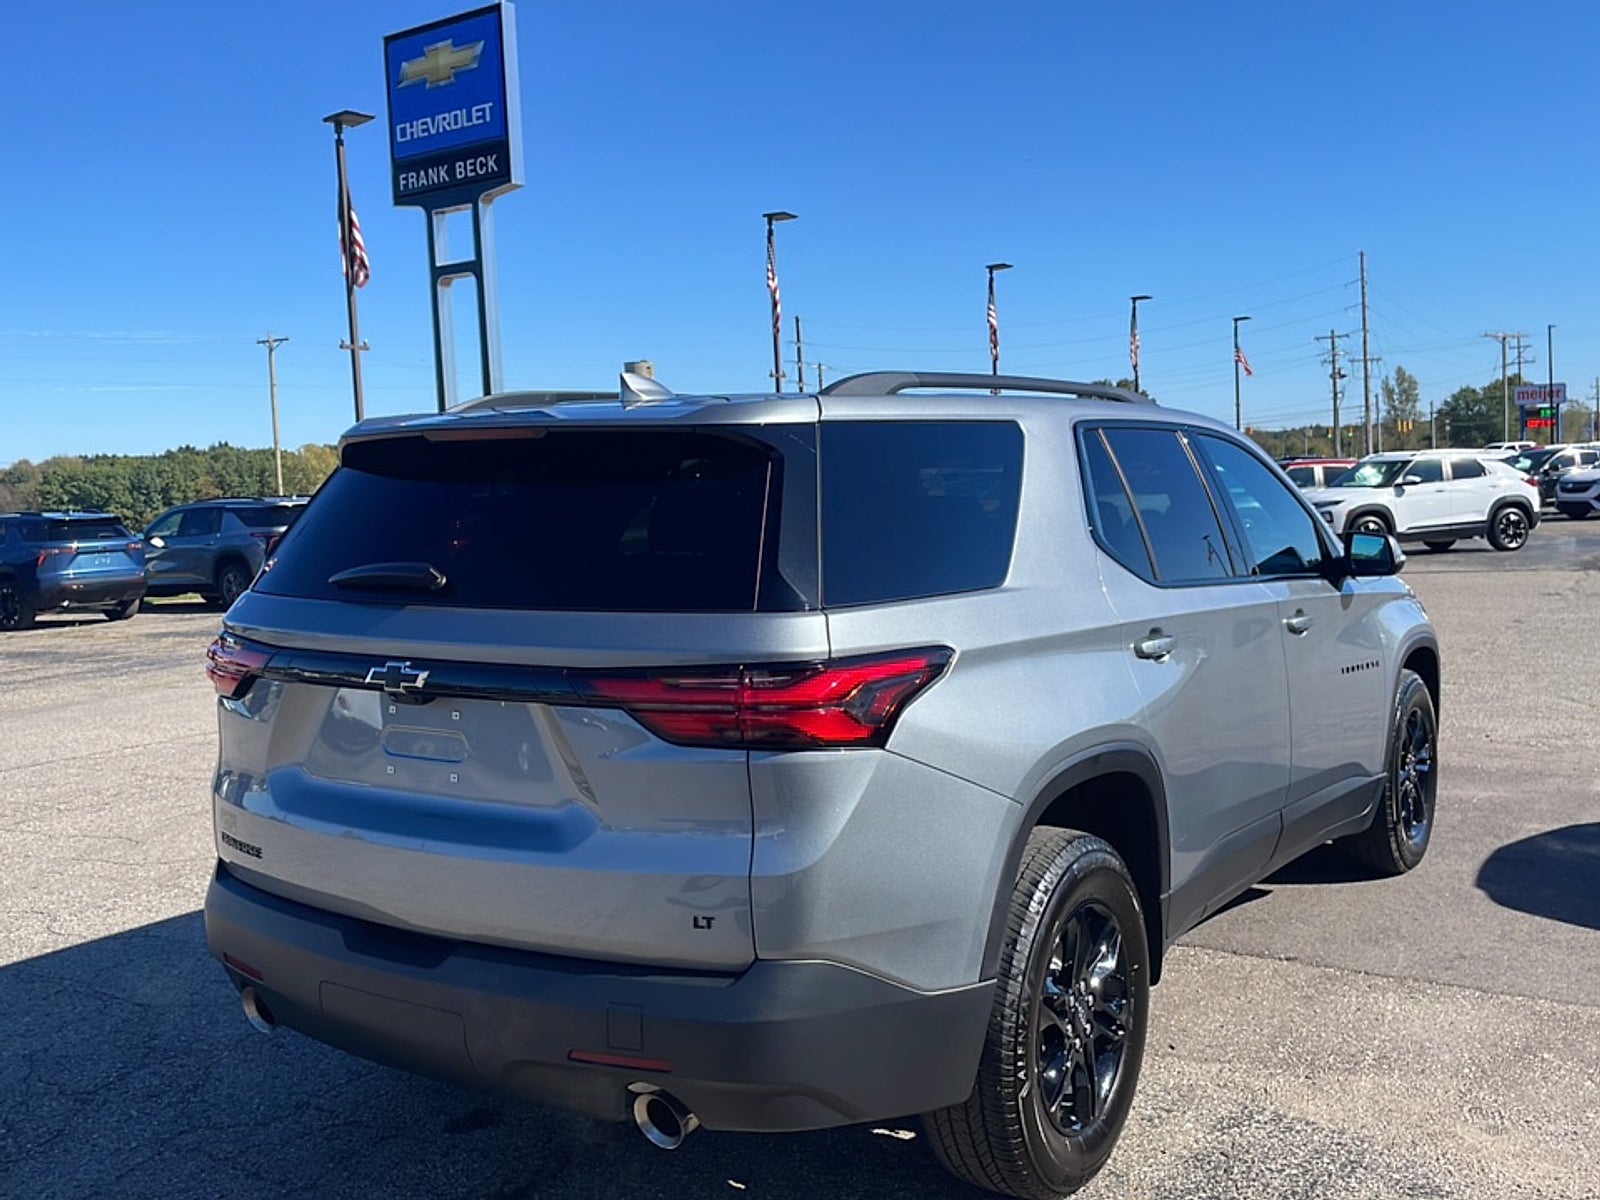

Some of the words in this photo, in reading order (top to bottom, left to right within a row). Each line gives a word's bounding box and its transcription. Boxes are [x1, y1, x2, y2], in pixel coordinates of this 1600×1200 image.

[396, 102, 493, 143] CHEVROLET
[399, 164, 450, 191] FRANK
[455, 153, 498, 180] BECK
[1517, 385, 1561, 402] meijer
[693, 915, 716, 930] LT
